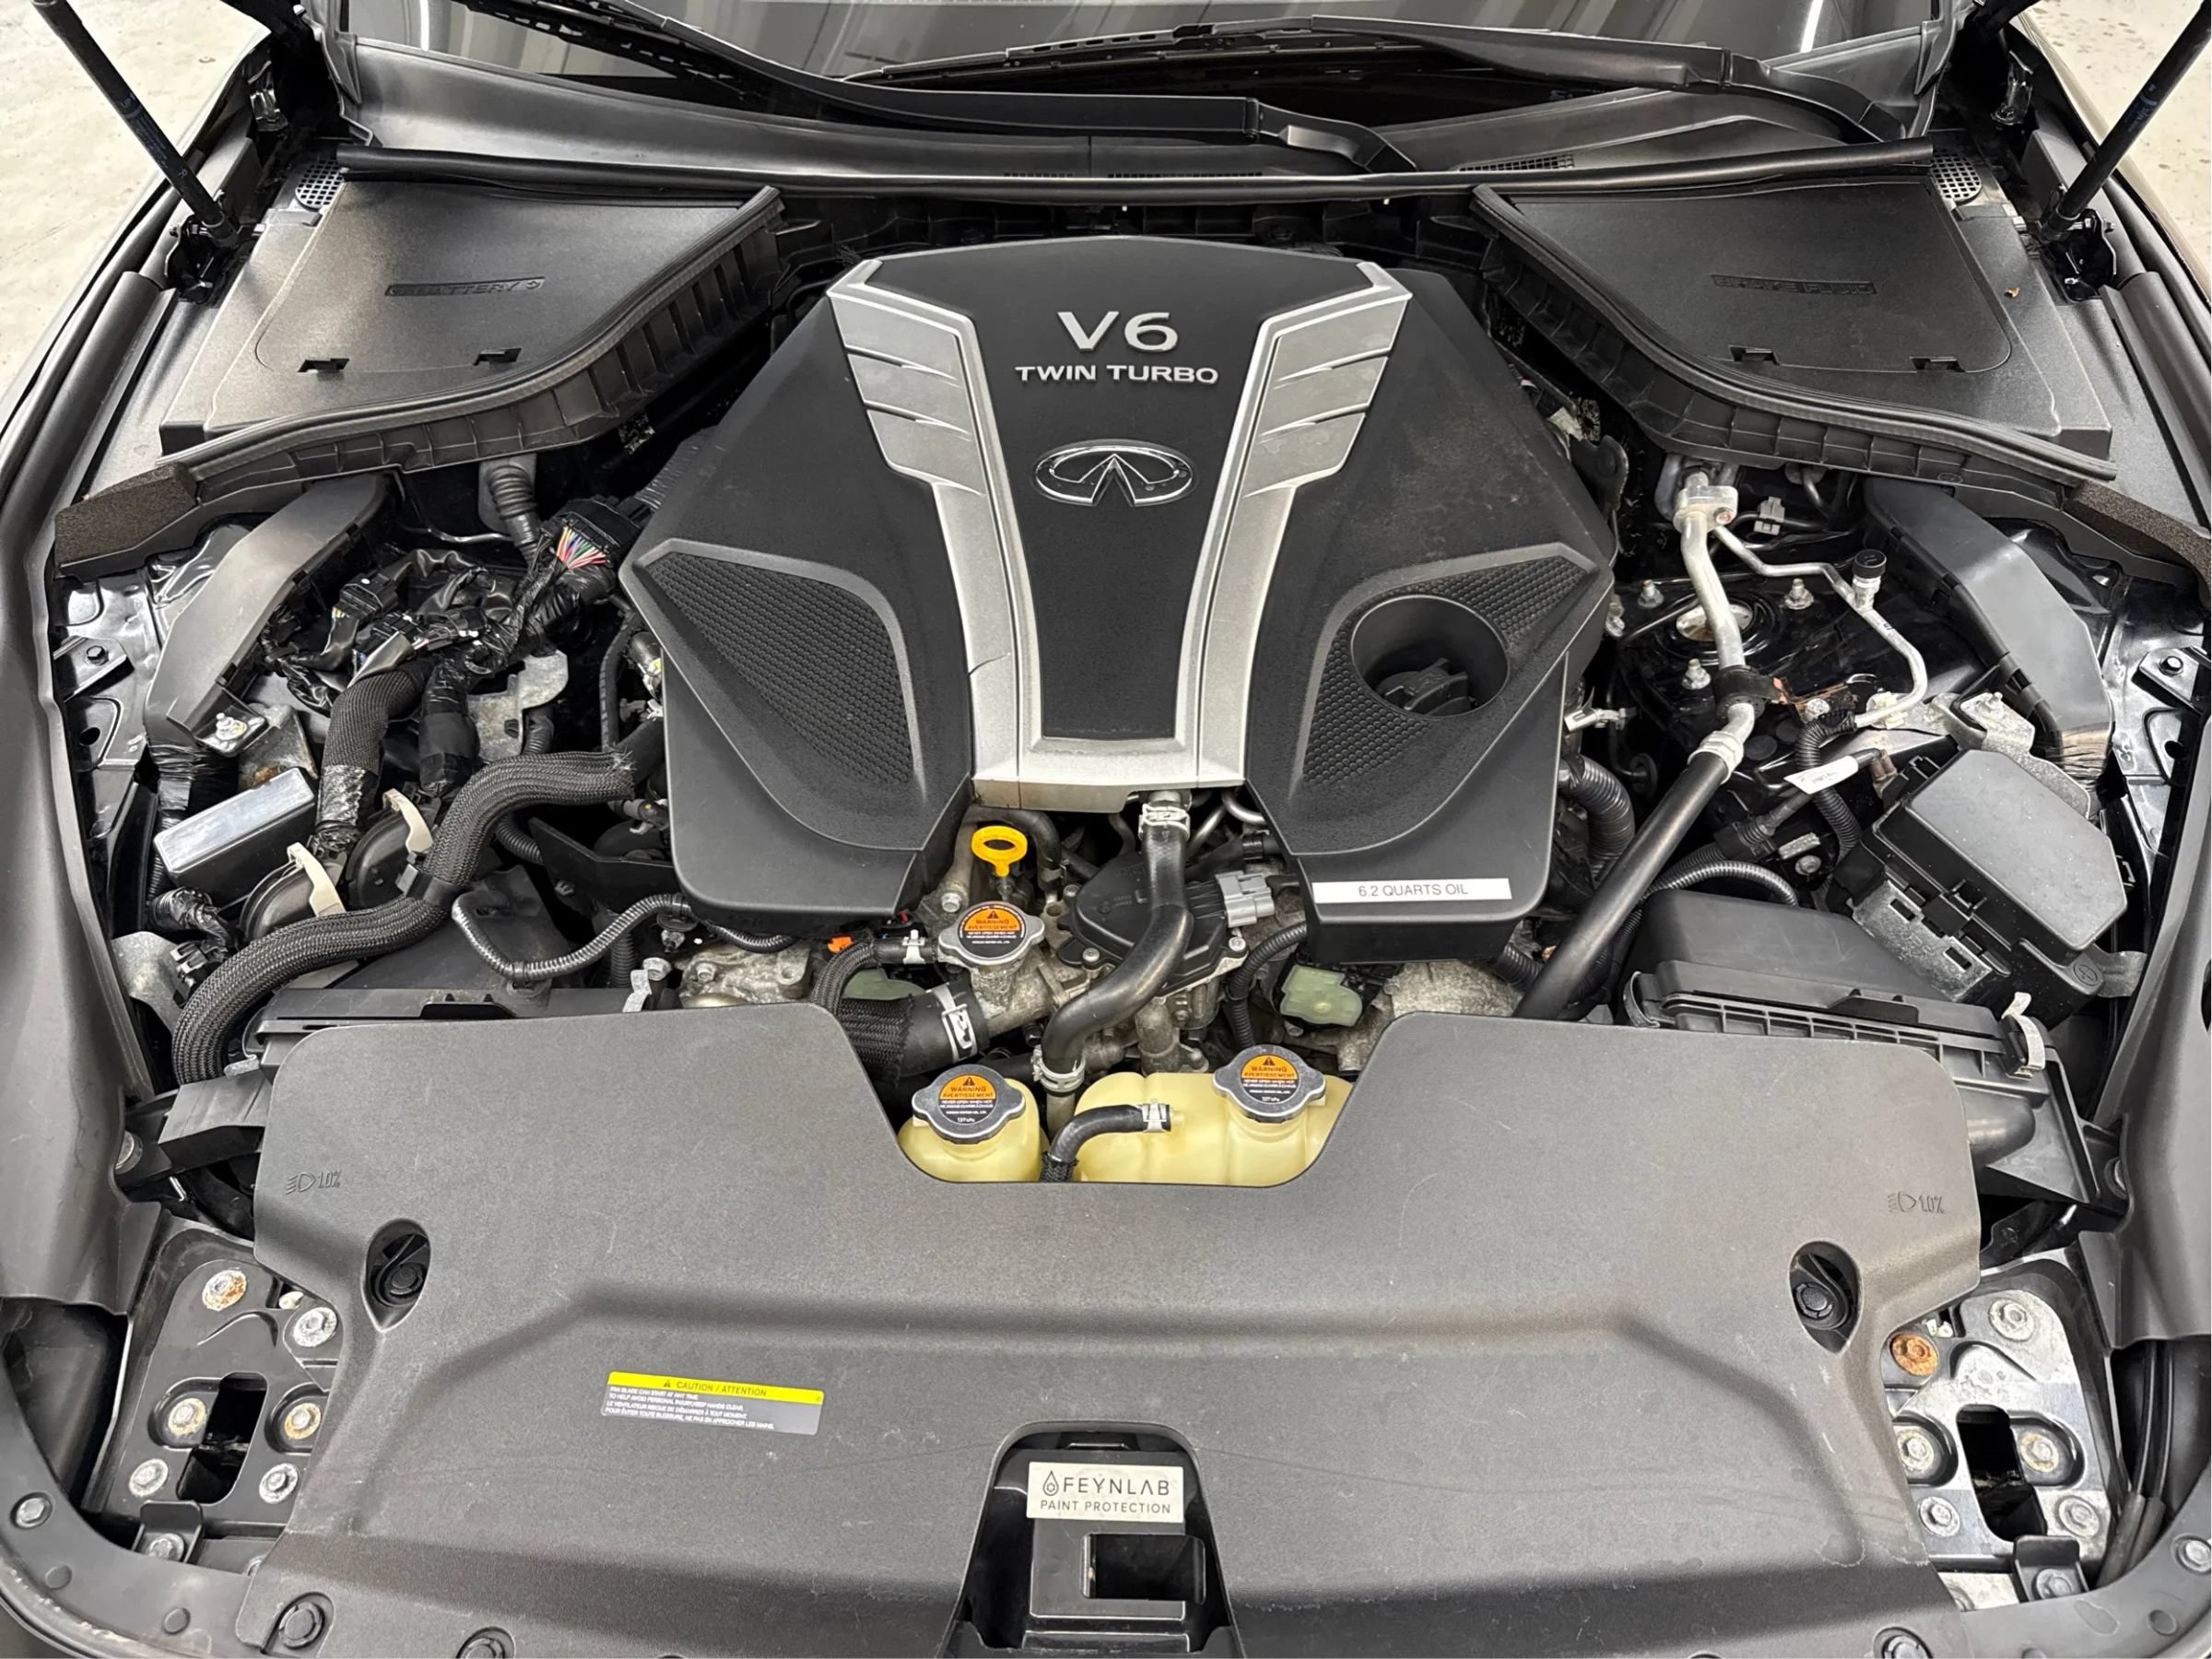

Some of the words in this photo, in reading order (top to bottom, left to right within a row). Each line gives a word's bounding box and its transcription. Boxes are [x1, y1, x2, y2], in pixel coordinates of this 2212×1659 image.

[418, 281, 521, 295] BATTERY
[1716, 277, 1797, 292] BRAKE
[1802, 282, 1874, 295] FLUID
[1057, 311, 1179, 352] V6
[1015, 365, 1097, 382] TWIN
[1106, 365, 1218, 384] TURBO
[1359, 885, 1379, 897] 6.2
[1382, 883, 1442, 897] QUARTS
[1445, 883, 1469, 895] OIL
[677, 1381, 712, 1391] CAUTION
[722, 1385, 767, 1396] ATTENTION
[1063, 1477, 1170, 1495] FEYNLAB
[1041, 1500, 1078, 1511] PAINT
[1085, 1501, 1171, 1514] PROTECTION
